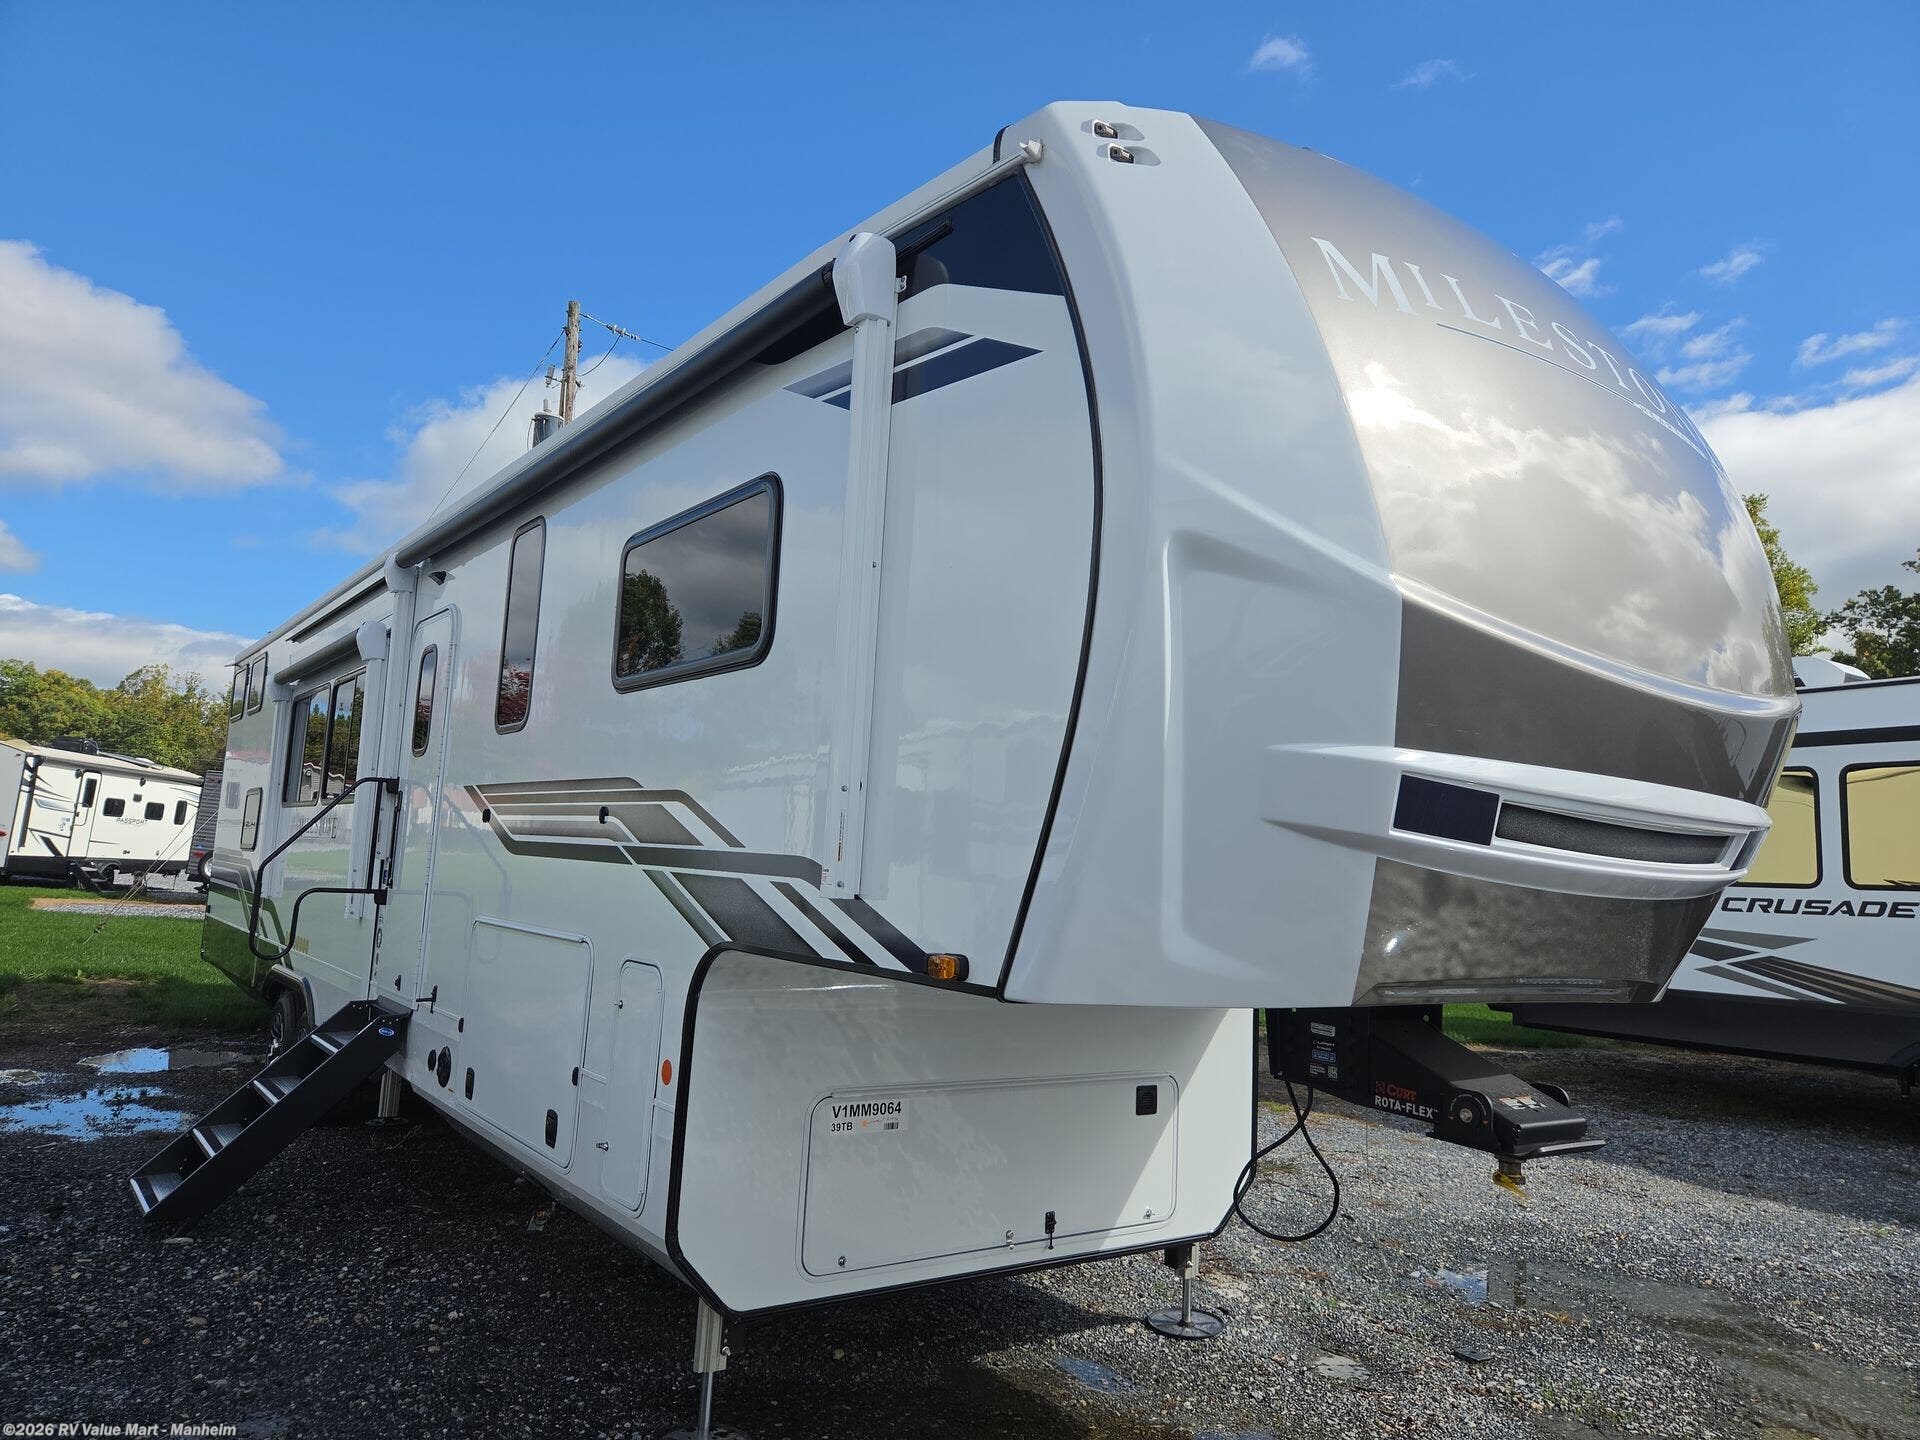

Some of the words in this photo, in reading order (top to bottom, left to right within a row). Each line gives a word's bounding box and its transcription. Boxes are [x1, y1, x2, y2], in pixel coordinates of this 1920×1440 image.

[1311, 236, 1711, 462] MILESTON
[1720, 897, 1920, 919] CRUSADE
[1386, 1083, 1417, 1101] CURT
[831, 1101, 902, 1118] V1MM9064
[831, 1122, 853, 1132] 39TB
